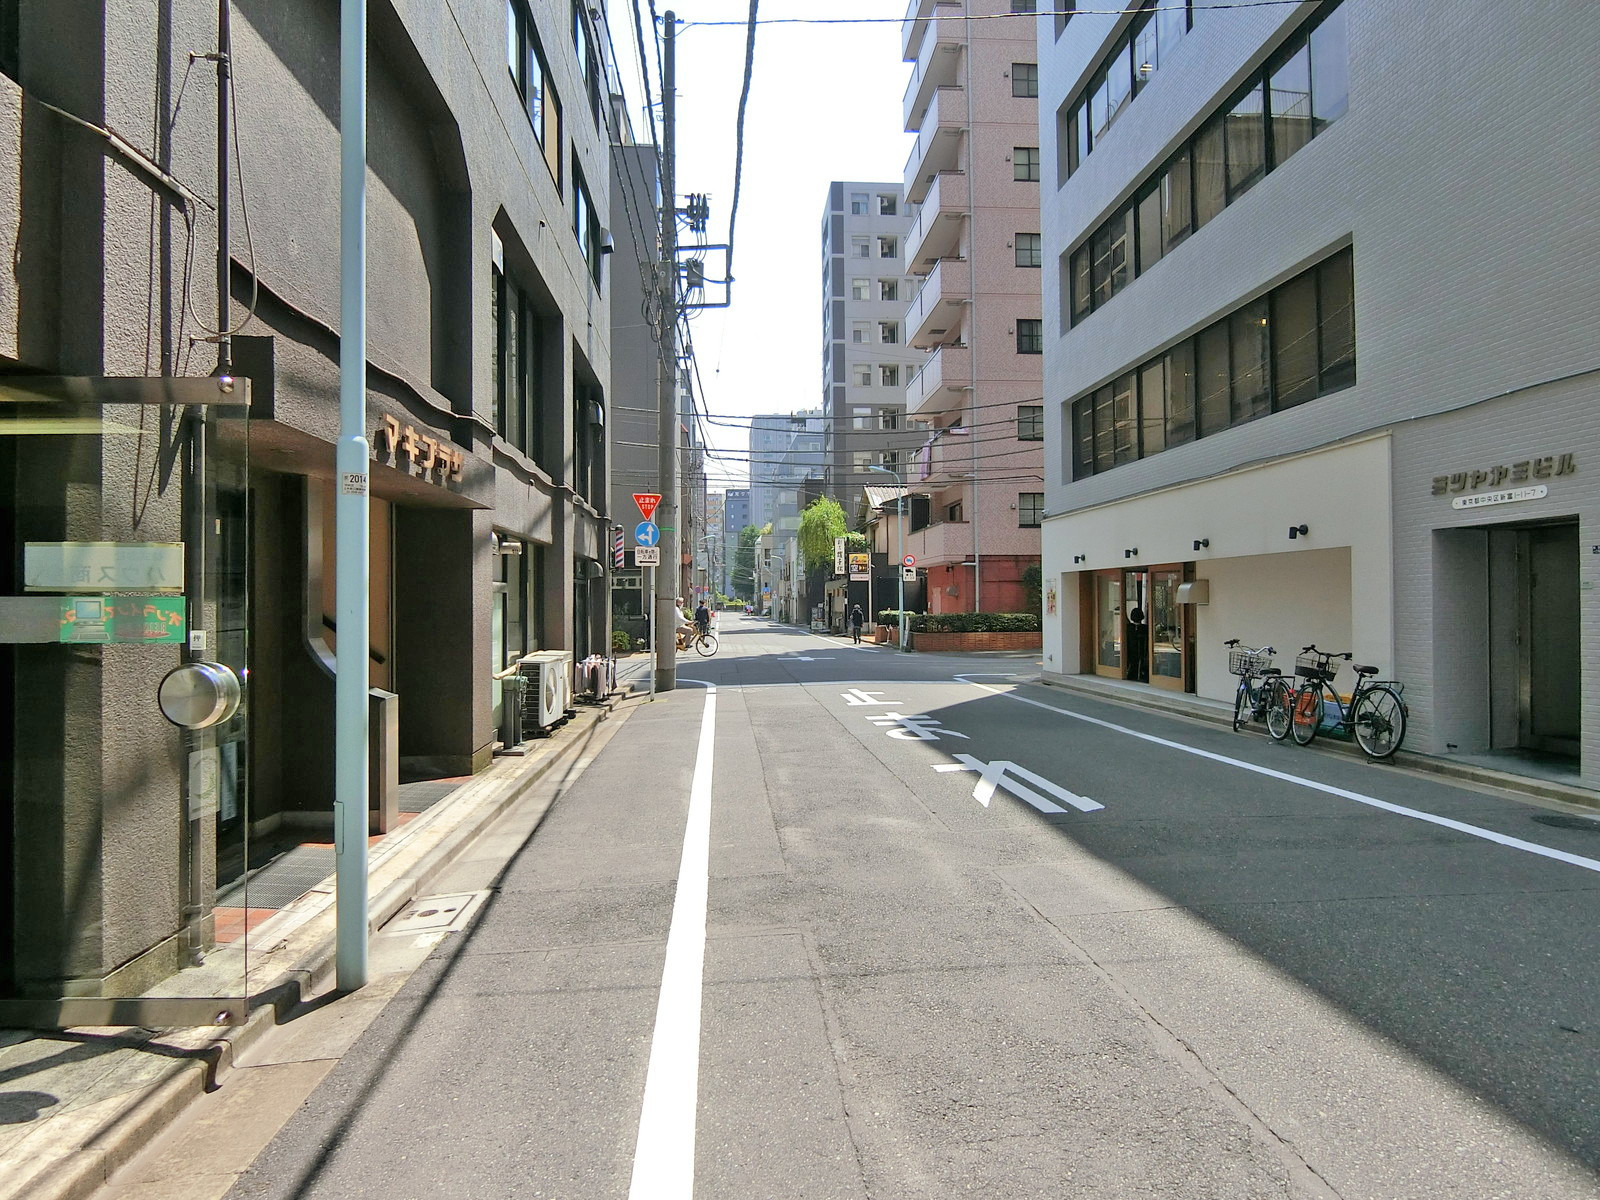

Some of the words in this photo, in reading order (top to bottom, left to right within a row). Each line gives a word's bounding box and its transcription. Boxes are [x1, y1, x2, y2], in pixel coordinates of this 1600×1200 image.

[383, 413, 464, 482] マキプラザ
[840, 688, 1105, 814] 止まれ
